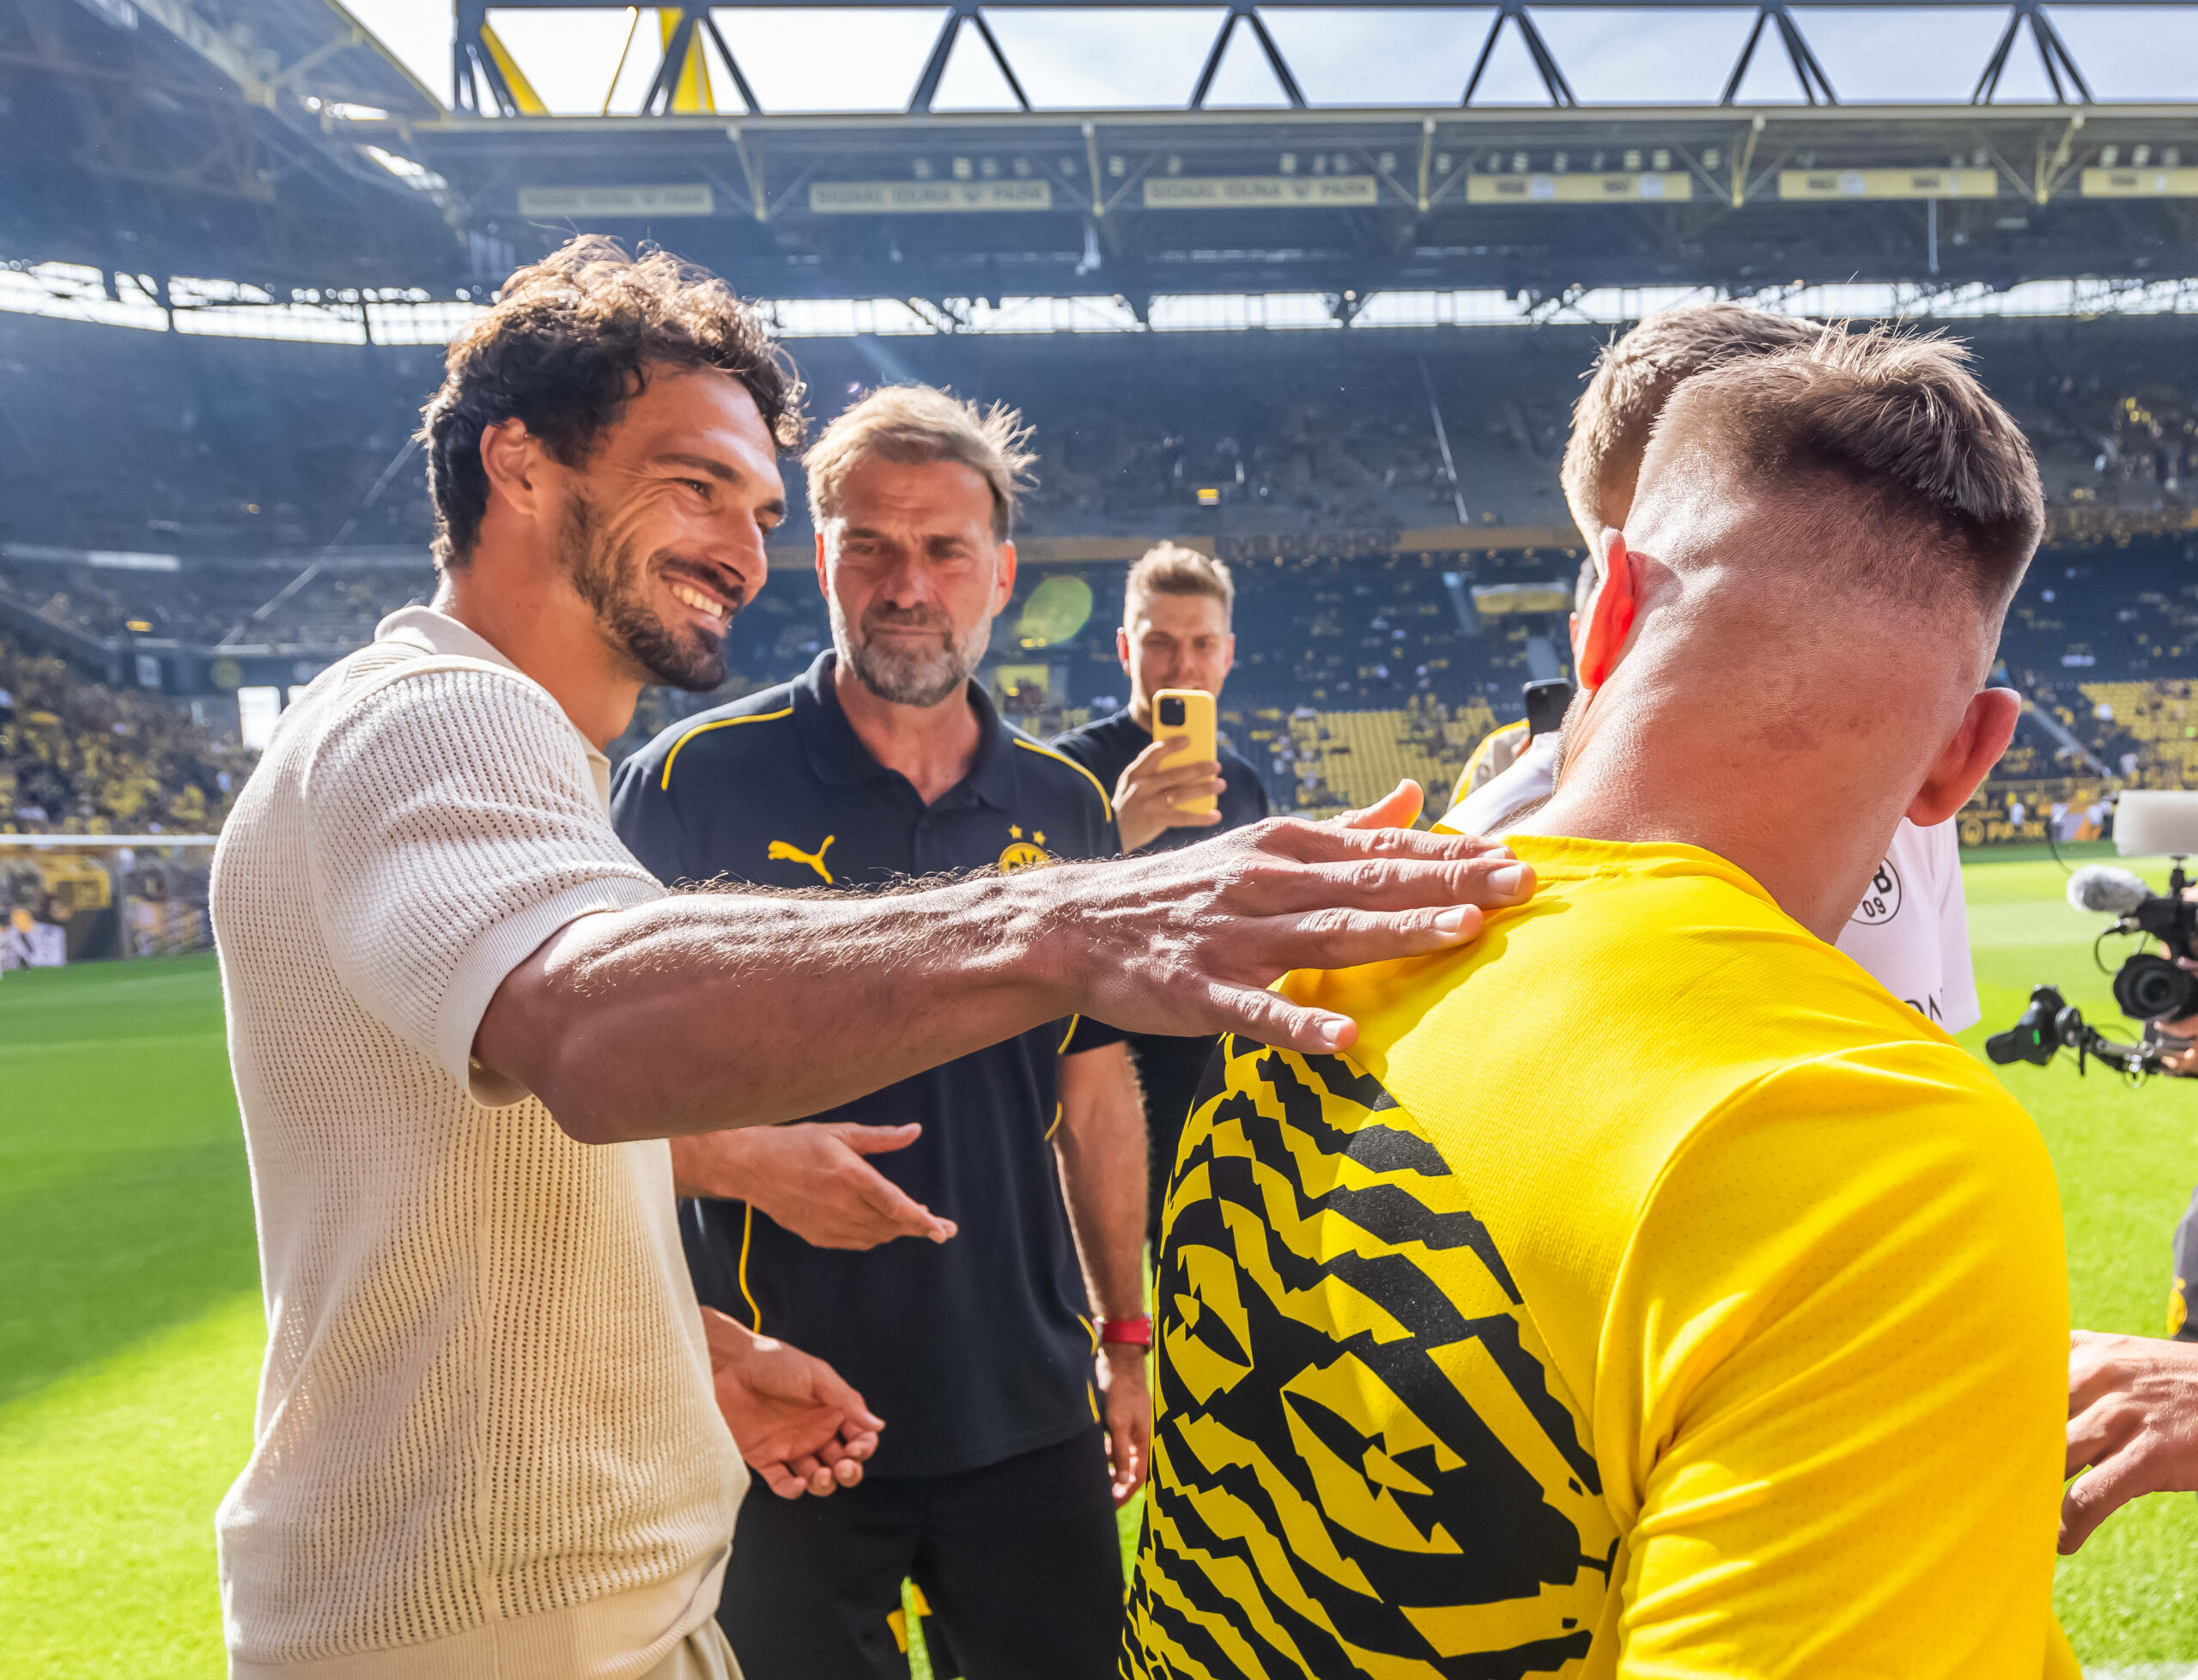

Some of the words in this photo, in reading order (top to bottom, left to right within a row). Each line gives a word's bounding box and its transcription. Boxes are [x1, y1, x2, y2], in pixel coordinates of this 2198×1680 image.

[817, 188, 882, 203] SIGNAL
[891, 187, 951, 203] IDUNA
[992, 185, 1042, 201] PARK
[1151, 183, 1217, 199] SIGNAL
[1223, 182, 1282, 198] IDUNA
[1320, 180, 1369, 197] PARK
[1862, 897, 1886, 918] 09
